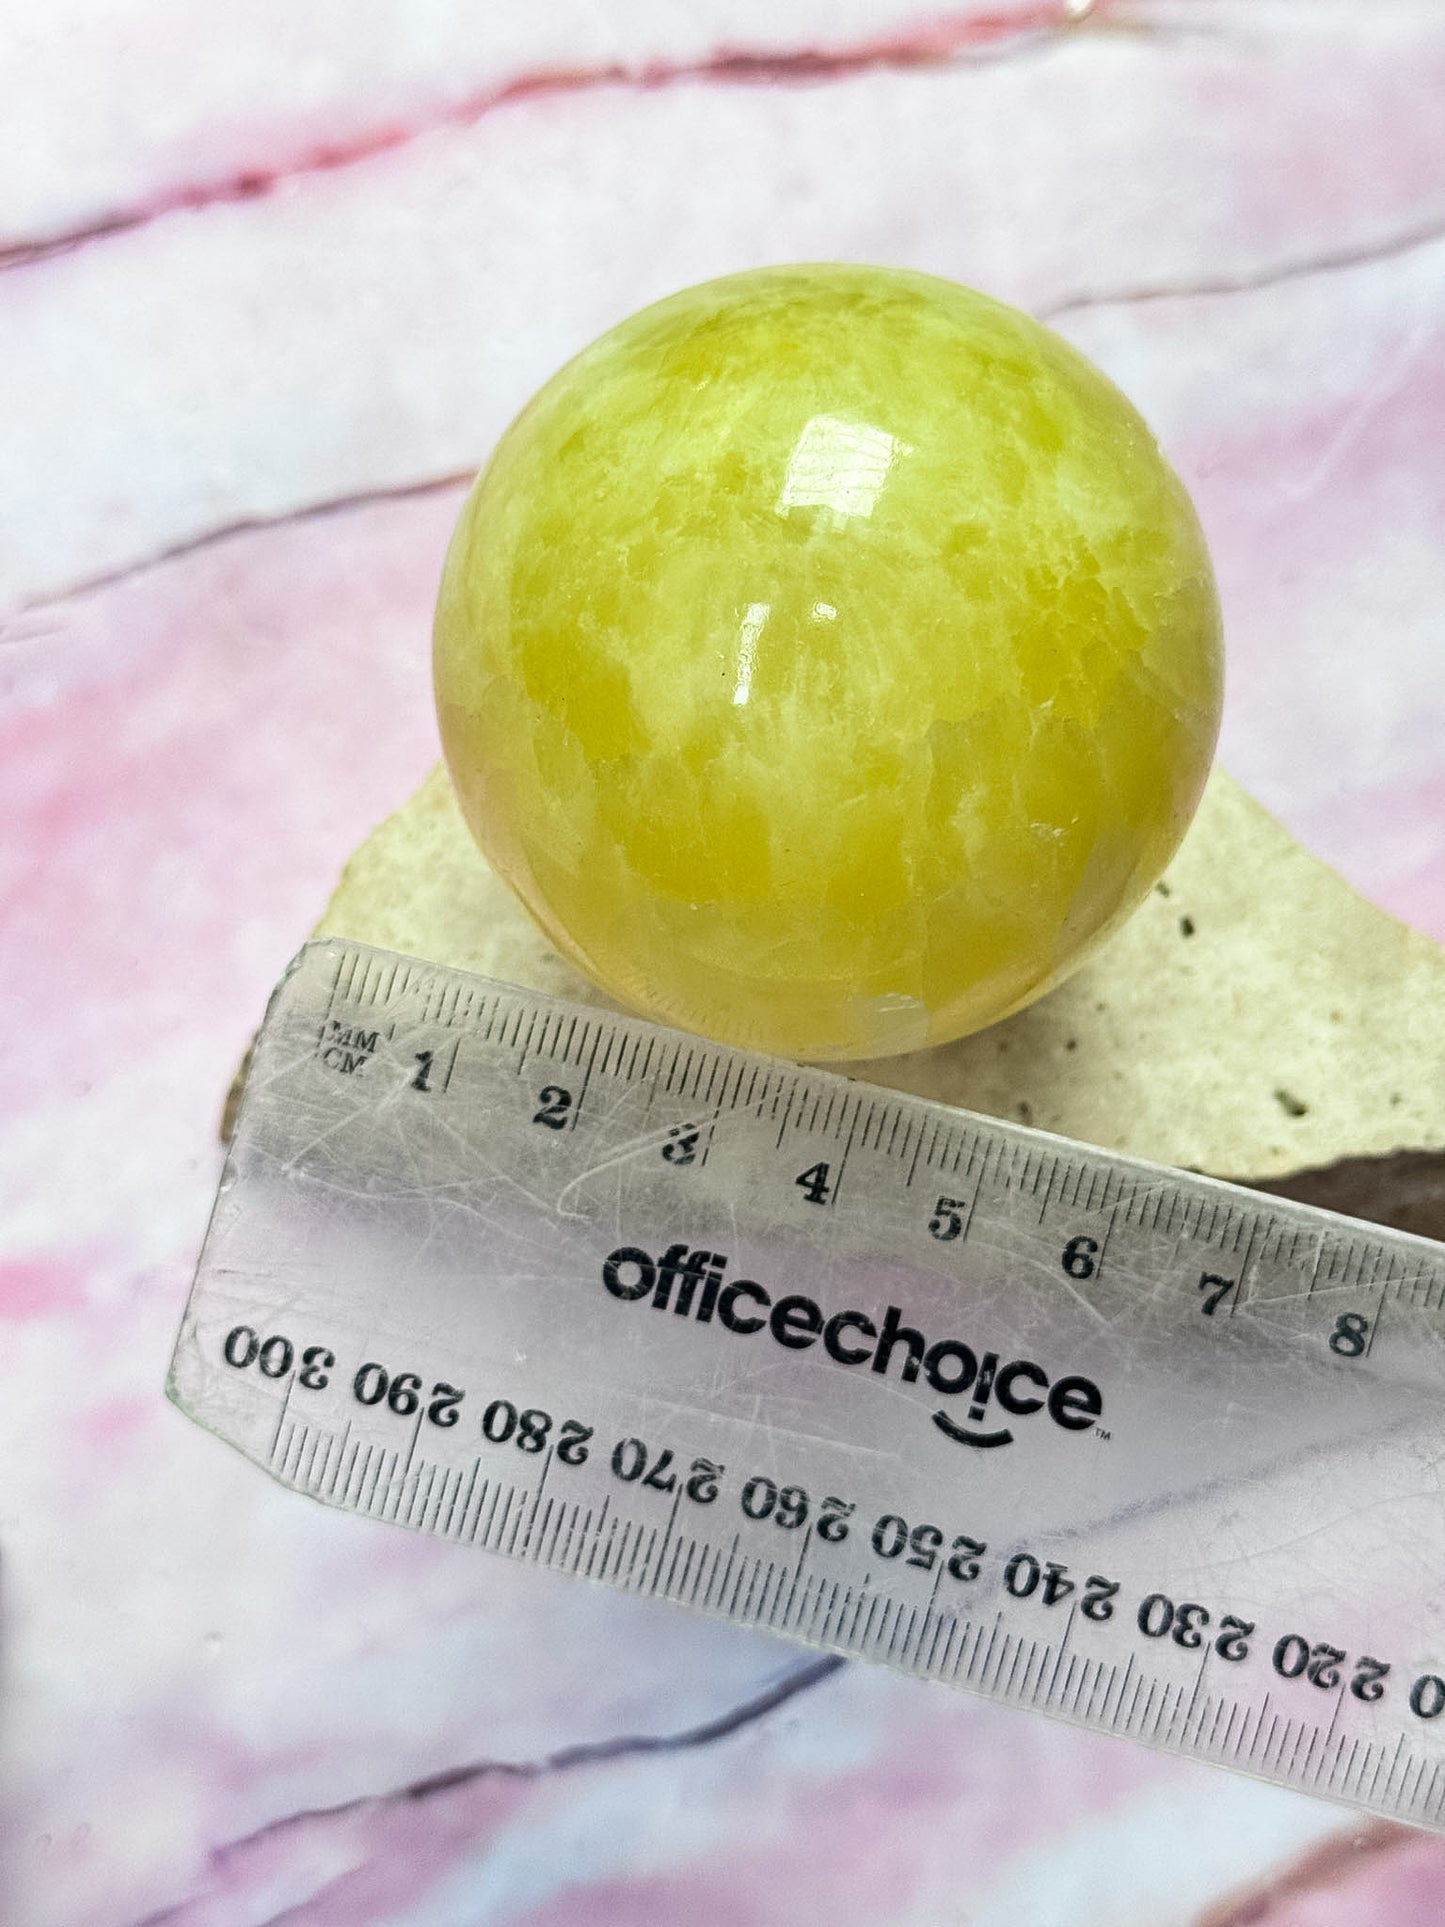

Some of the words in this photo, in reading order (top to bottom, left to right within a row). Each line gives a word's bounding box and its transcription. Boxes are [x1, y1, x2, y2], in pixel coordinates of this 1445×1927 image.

[323, 1047, 368, 1077] CM
[326, 1020, 380, 1053] MM
[412, 1051, 435, 1093] 1
[532, 1085, 573, 1130] 2
[661, 1122, 699, 1165] 3
[796, 1162, 829, 1205] 4
[928, 1195, 965, 1241] 5
[1061, 1236, 1098, 1279] 6
[1199, 1272, 1234, 1317] 7
[1328, 1312, 1368, 1357] 8
[224, 1325, 336, 1390] 300
[353, 1362, 465, 1427] 290
[482, 1399, 594, 1465] 280
[611, 1438, 726, 1504] 270
[740, 1476, 856, 1543] 260
[871, 1514, 987, 1582] 250
[1004, 1552, 1121, 1622] 240
[1137, 1592, 1256, 1662] 230
[1272, 1632, 1391, 1702] 220
